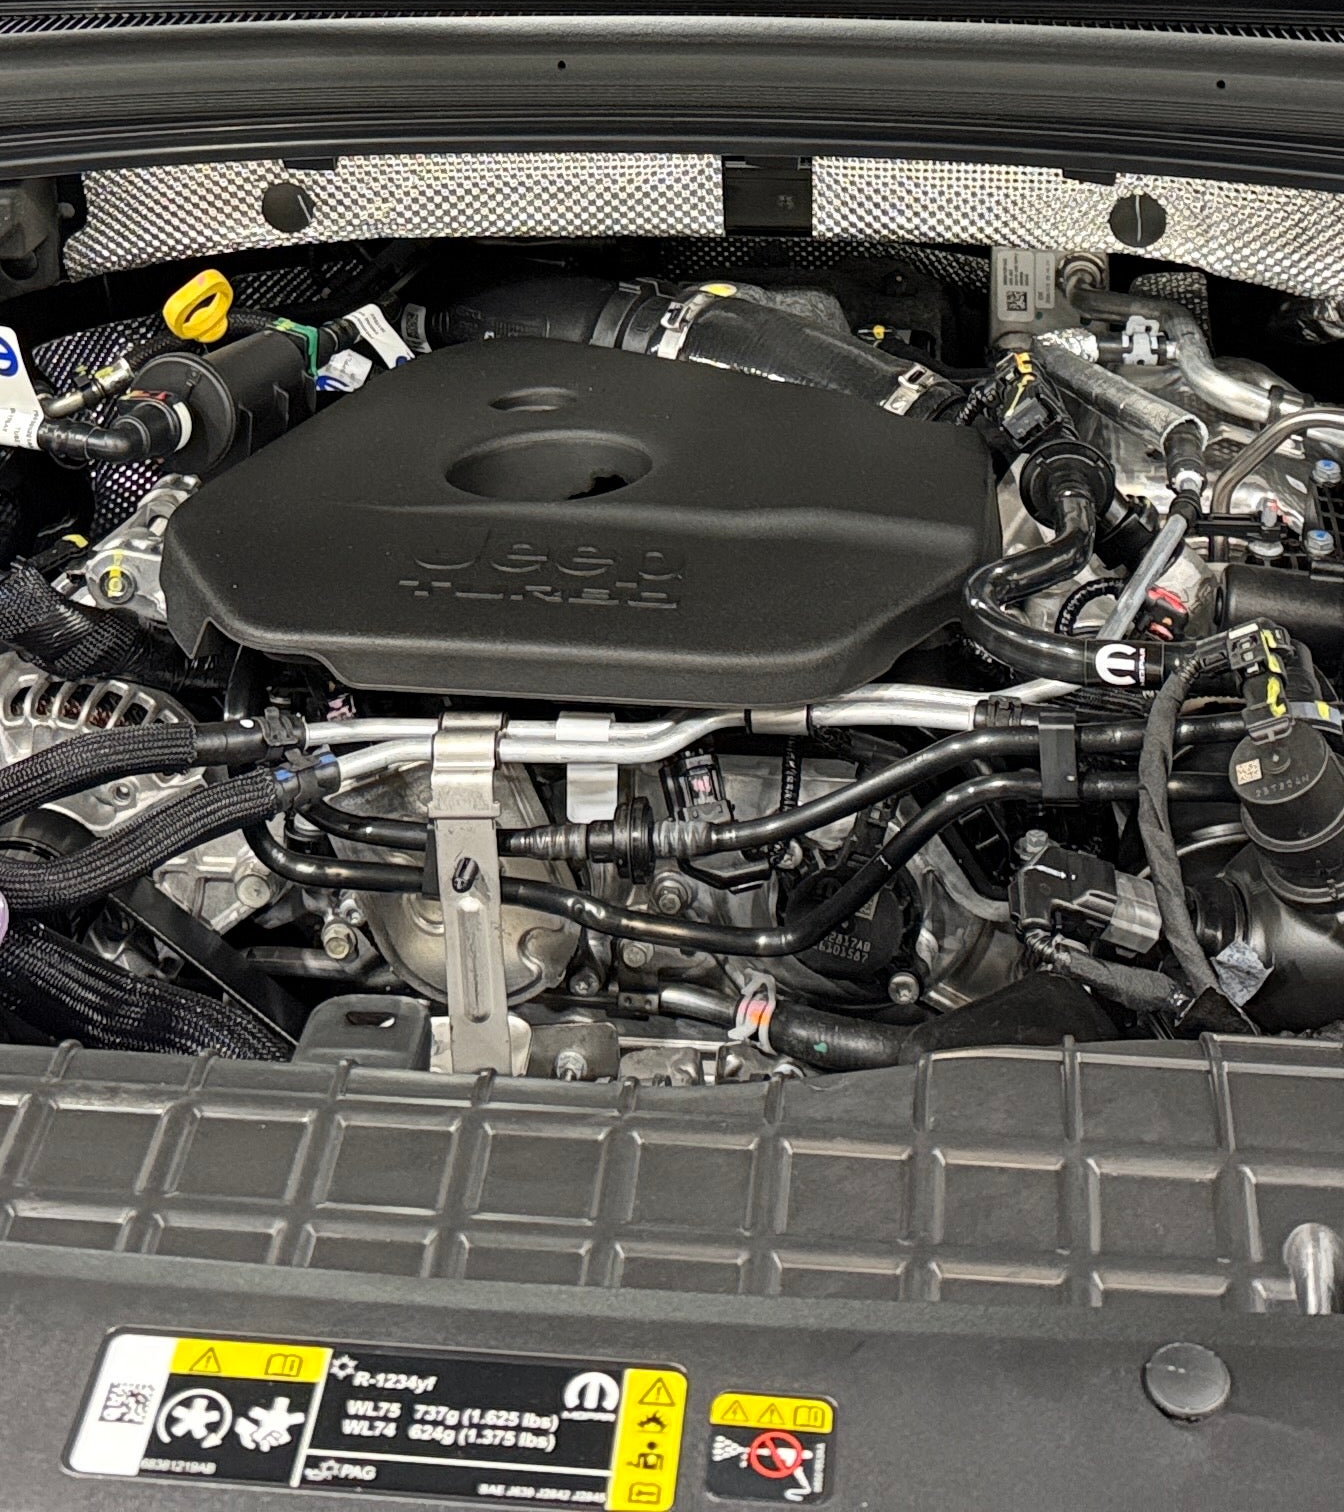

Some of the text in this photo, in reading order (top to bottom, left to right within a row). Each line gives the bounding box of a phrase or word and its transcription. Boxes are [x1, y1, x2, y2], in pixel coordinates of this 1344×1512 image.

[413, 528, 686, 587] Jeep
[352, 1373, 437, 1394] R-1234yf
[346, 1400, 559, 1433] WL75 737g (1.625 lbs)
[341, 1419, 556, 1452] WL74 624g (1.375 lbs)
[339, 1463, 376, 1481] PAG
